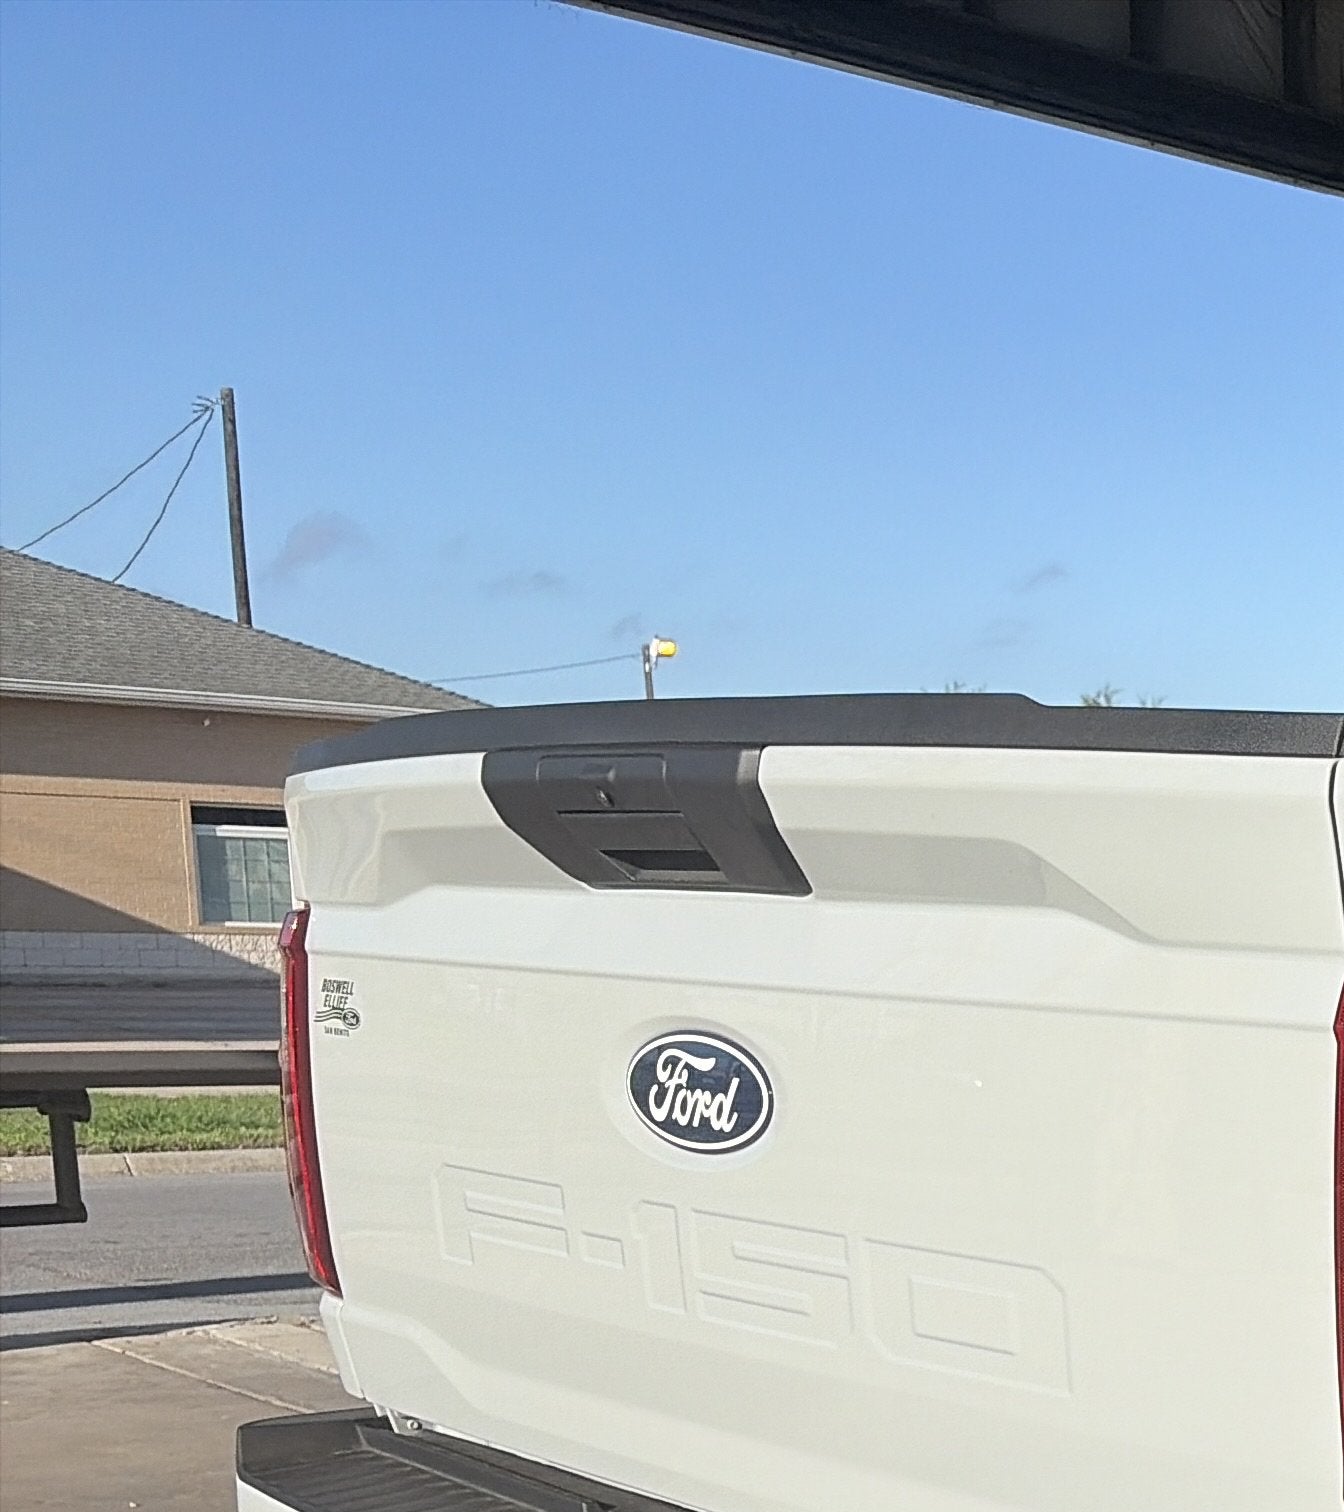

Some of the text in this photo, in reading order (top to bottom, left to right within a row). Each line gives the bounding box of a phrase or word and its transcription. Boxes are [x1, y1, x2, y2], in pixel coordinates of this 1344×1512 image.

[321, 978, 355, 996] BOSWELL
[649, 1048, 740, 1133] Ford
[432, 1163, 1073, 1398] F-150
